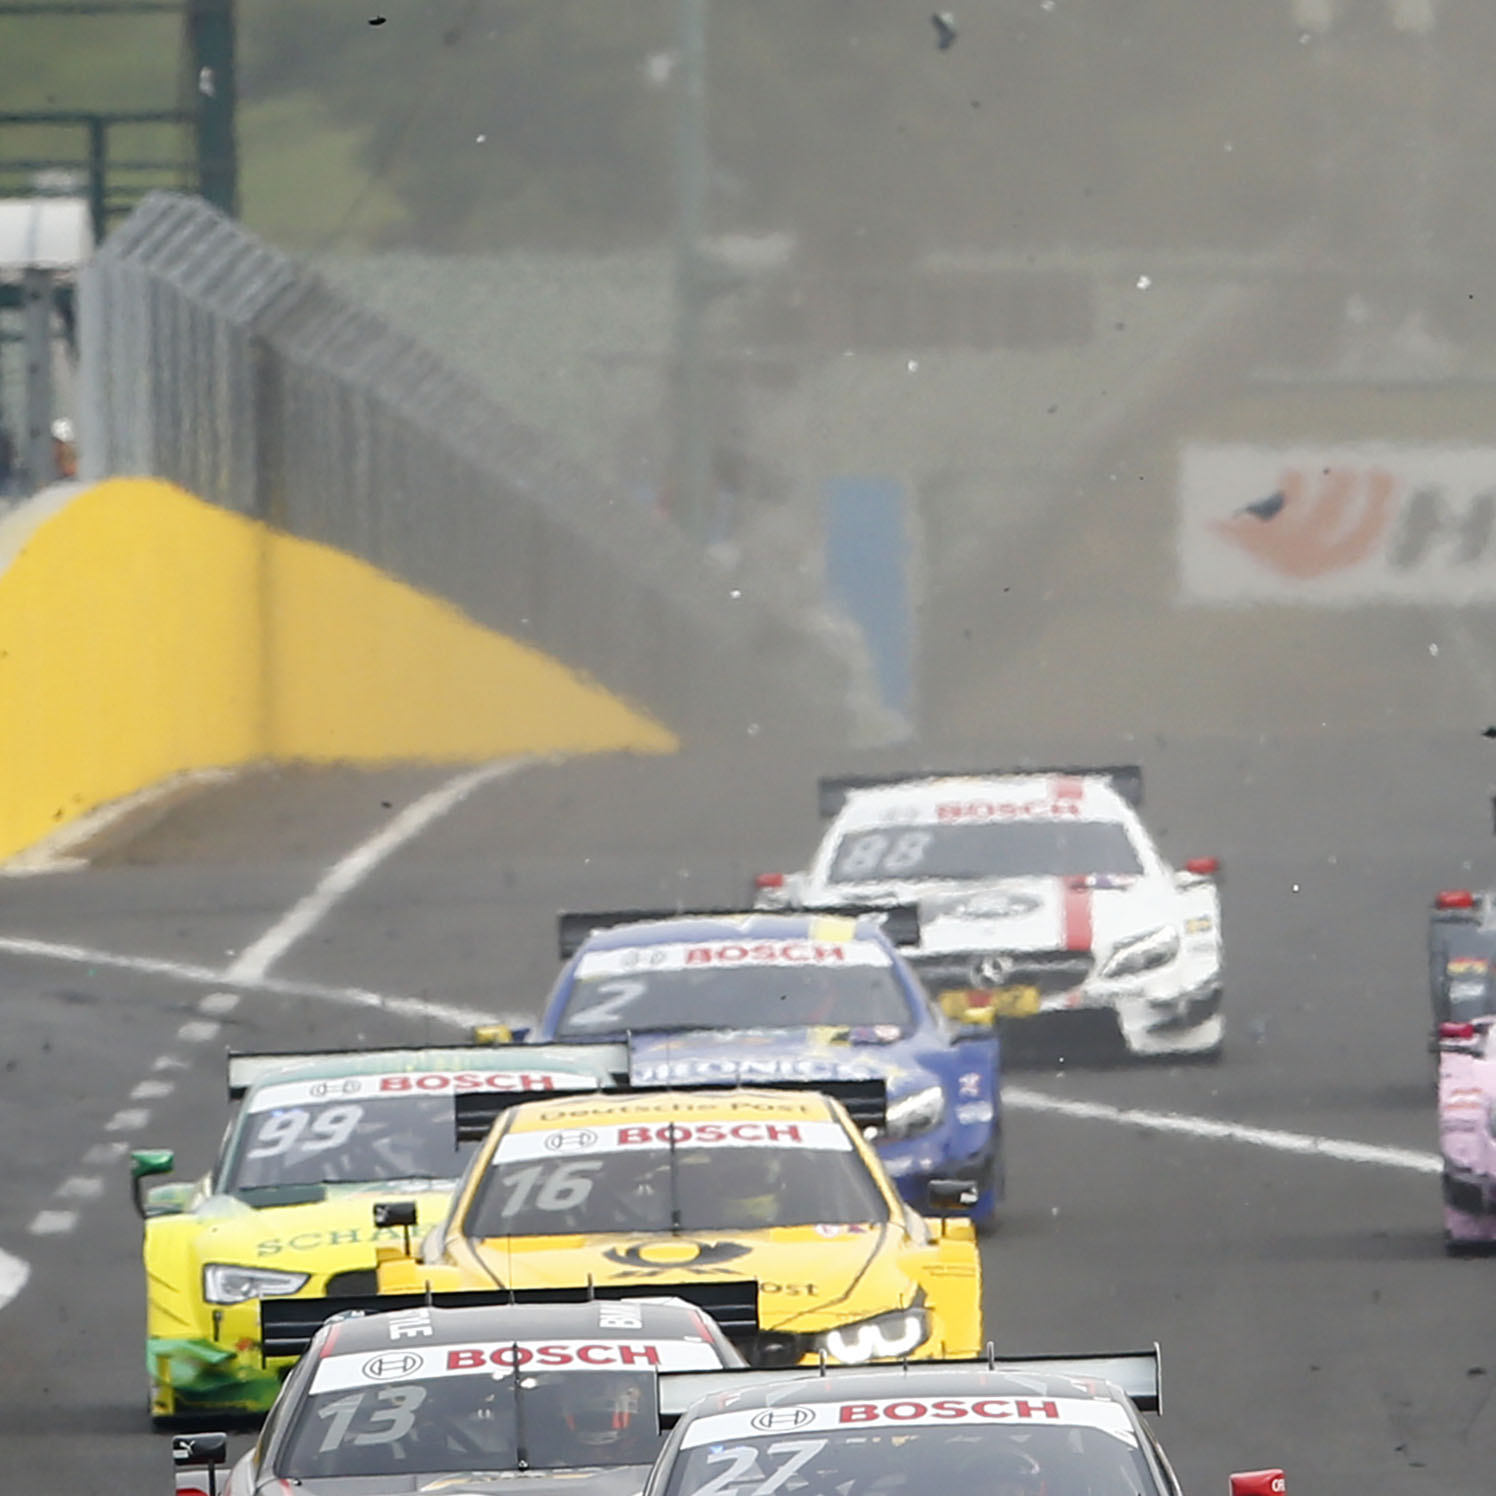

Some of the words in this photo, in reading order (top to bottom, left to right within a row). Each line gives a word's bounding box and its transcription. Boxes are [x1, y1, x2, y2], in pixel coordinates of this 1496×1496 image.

[936, 798, 1081, 824] BOSCH
[838, 831, 934, 874] 88
[683, 943, 846, 968] BOSCH
[569, 981, 646, 1026] 2
[379, 1073, 555, 1094] BOSCH
[246, 1104, 366, 1160] 99
[616, 1123, 803, 1147] BOSCH
[500, 1160, 604, 1218] 16
[757, 1281, 819, 1298] ost
[445, 1344, 662, 1371] BOSCH
[315, 1383, 428, 1454] 13
[837, 1399, 1060, 1424] BOSCH
